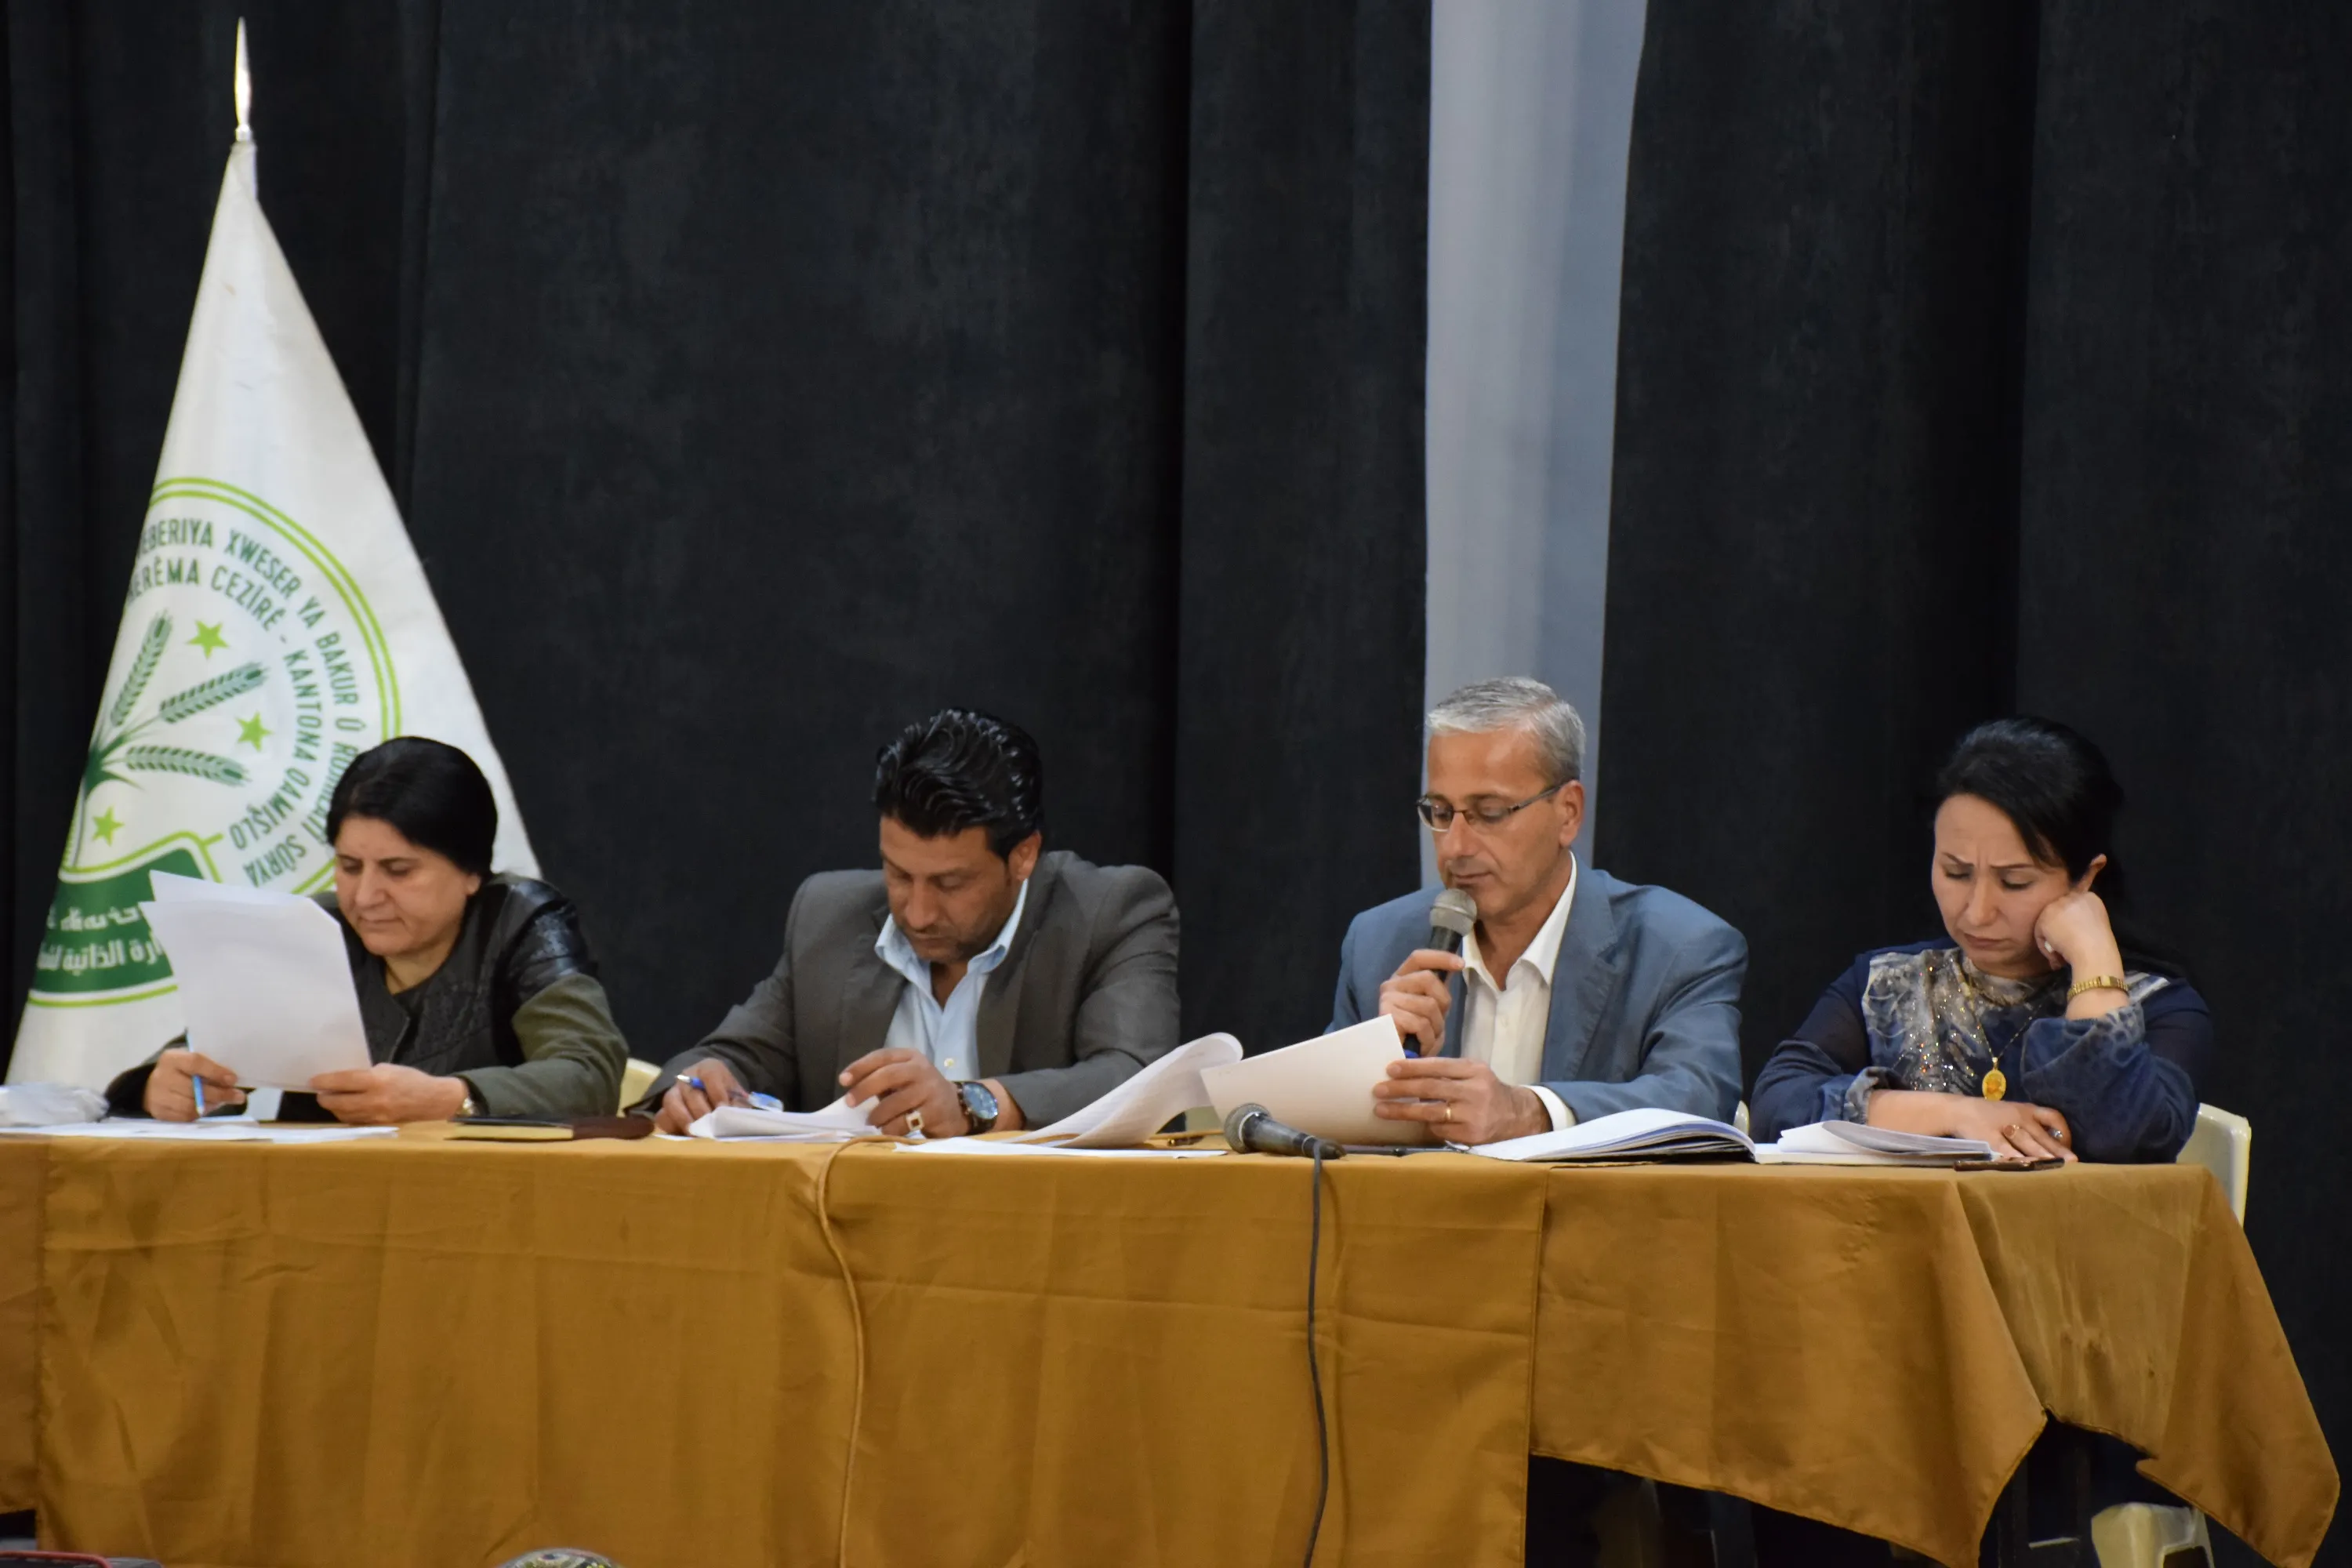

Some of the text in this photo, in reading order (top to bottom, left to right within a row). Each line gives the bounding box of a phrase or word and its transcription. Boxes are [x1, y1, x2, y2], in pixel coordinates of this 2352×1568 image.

[223, 528, 301, 600] XWESER
[297, 596, 325, 628] YA
[315, 632, 358, 704] BAKUR
[283, 649, 321, 762] KANTONA
